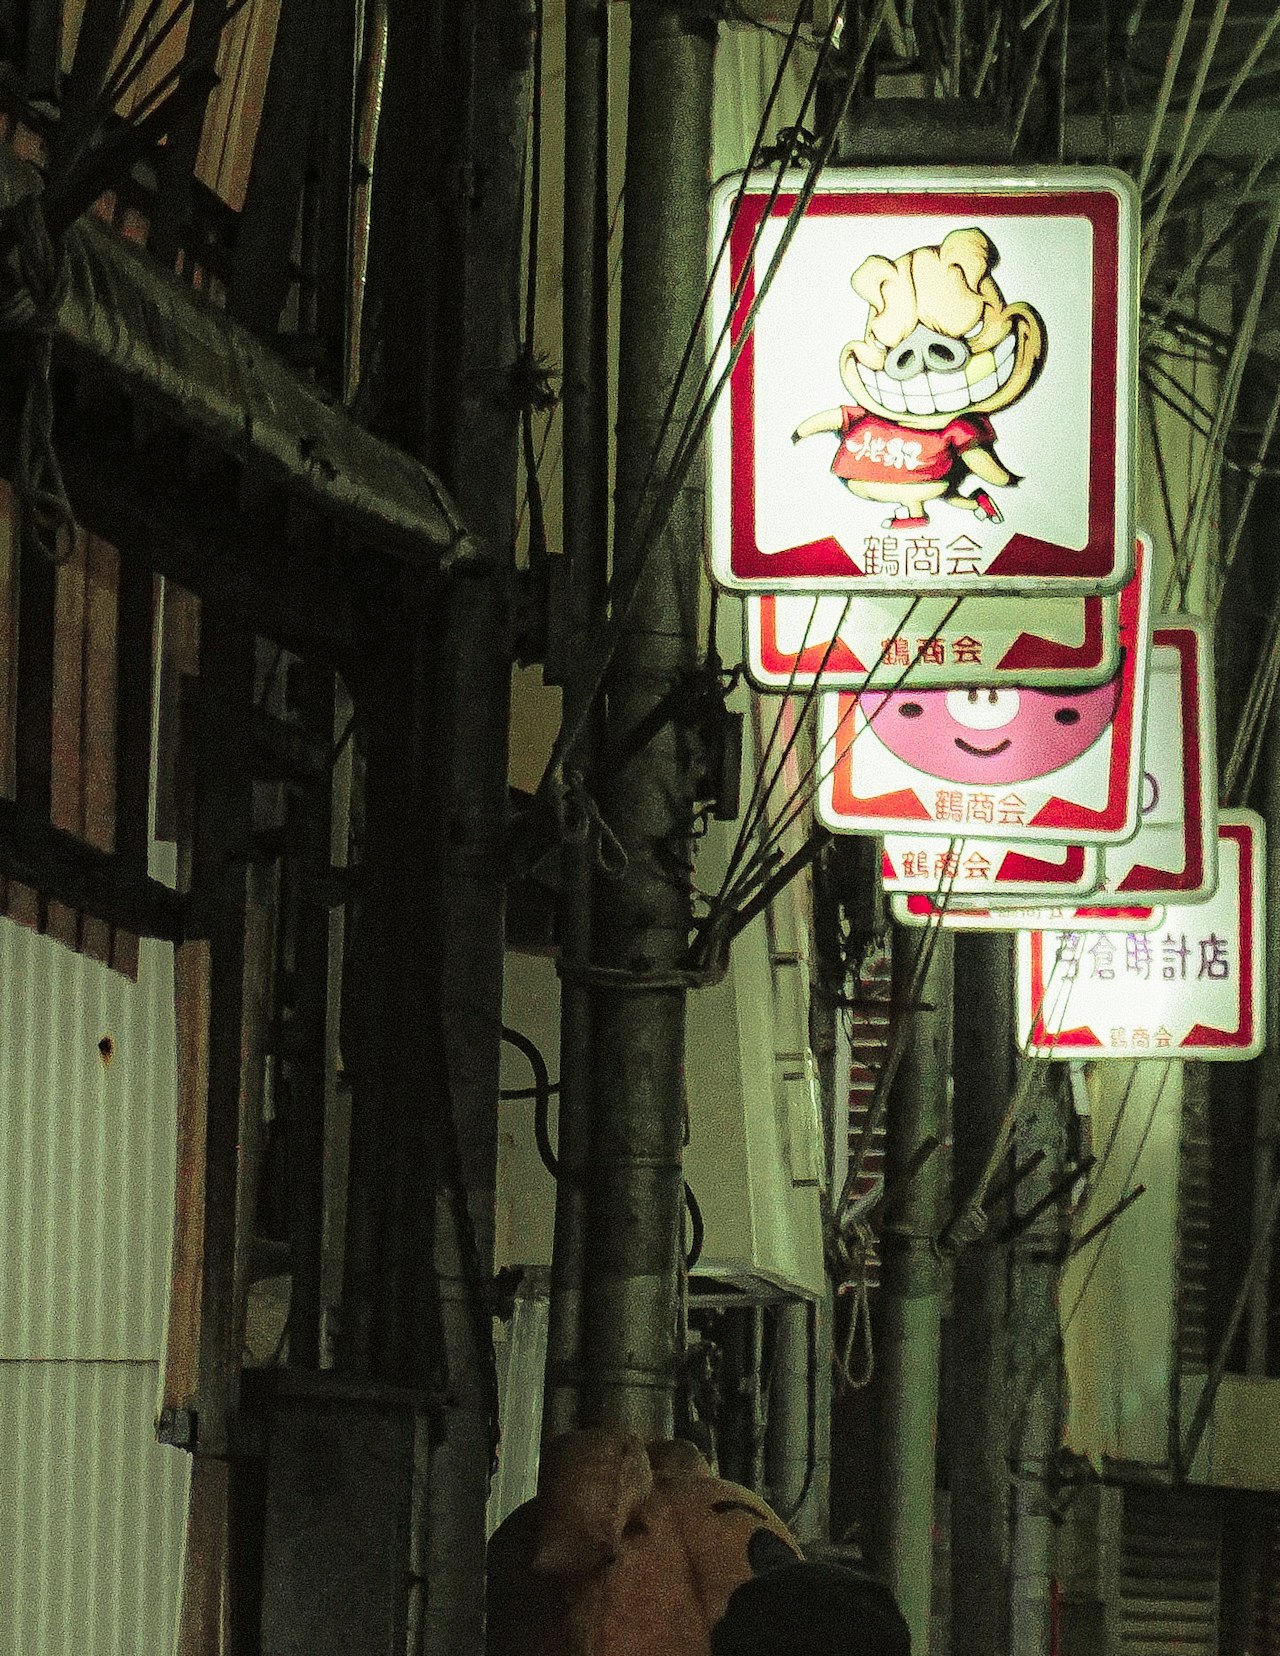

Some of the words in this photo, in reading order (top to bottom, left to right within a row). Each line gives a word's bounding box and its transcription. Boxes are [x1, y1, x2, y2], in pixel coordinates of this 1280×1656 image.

[863, 534, 984, 577] 鶴商会
[880, 634, 983, 666] 鶴商会
[935, 790, 1027, 826] 鶴商会
[902, 851, 991, 880] 鶴商会
